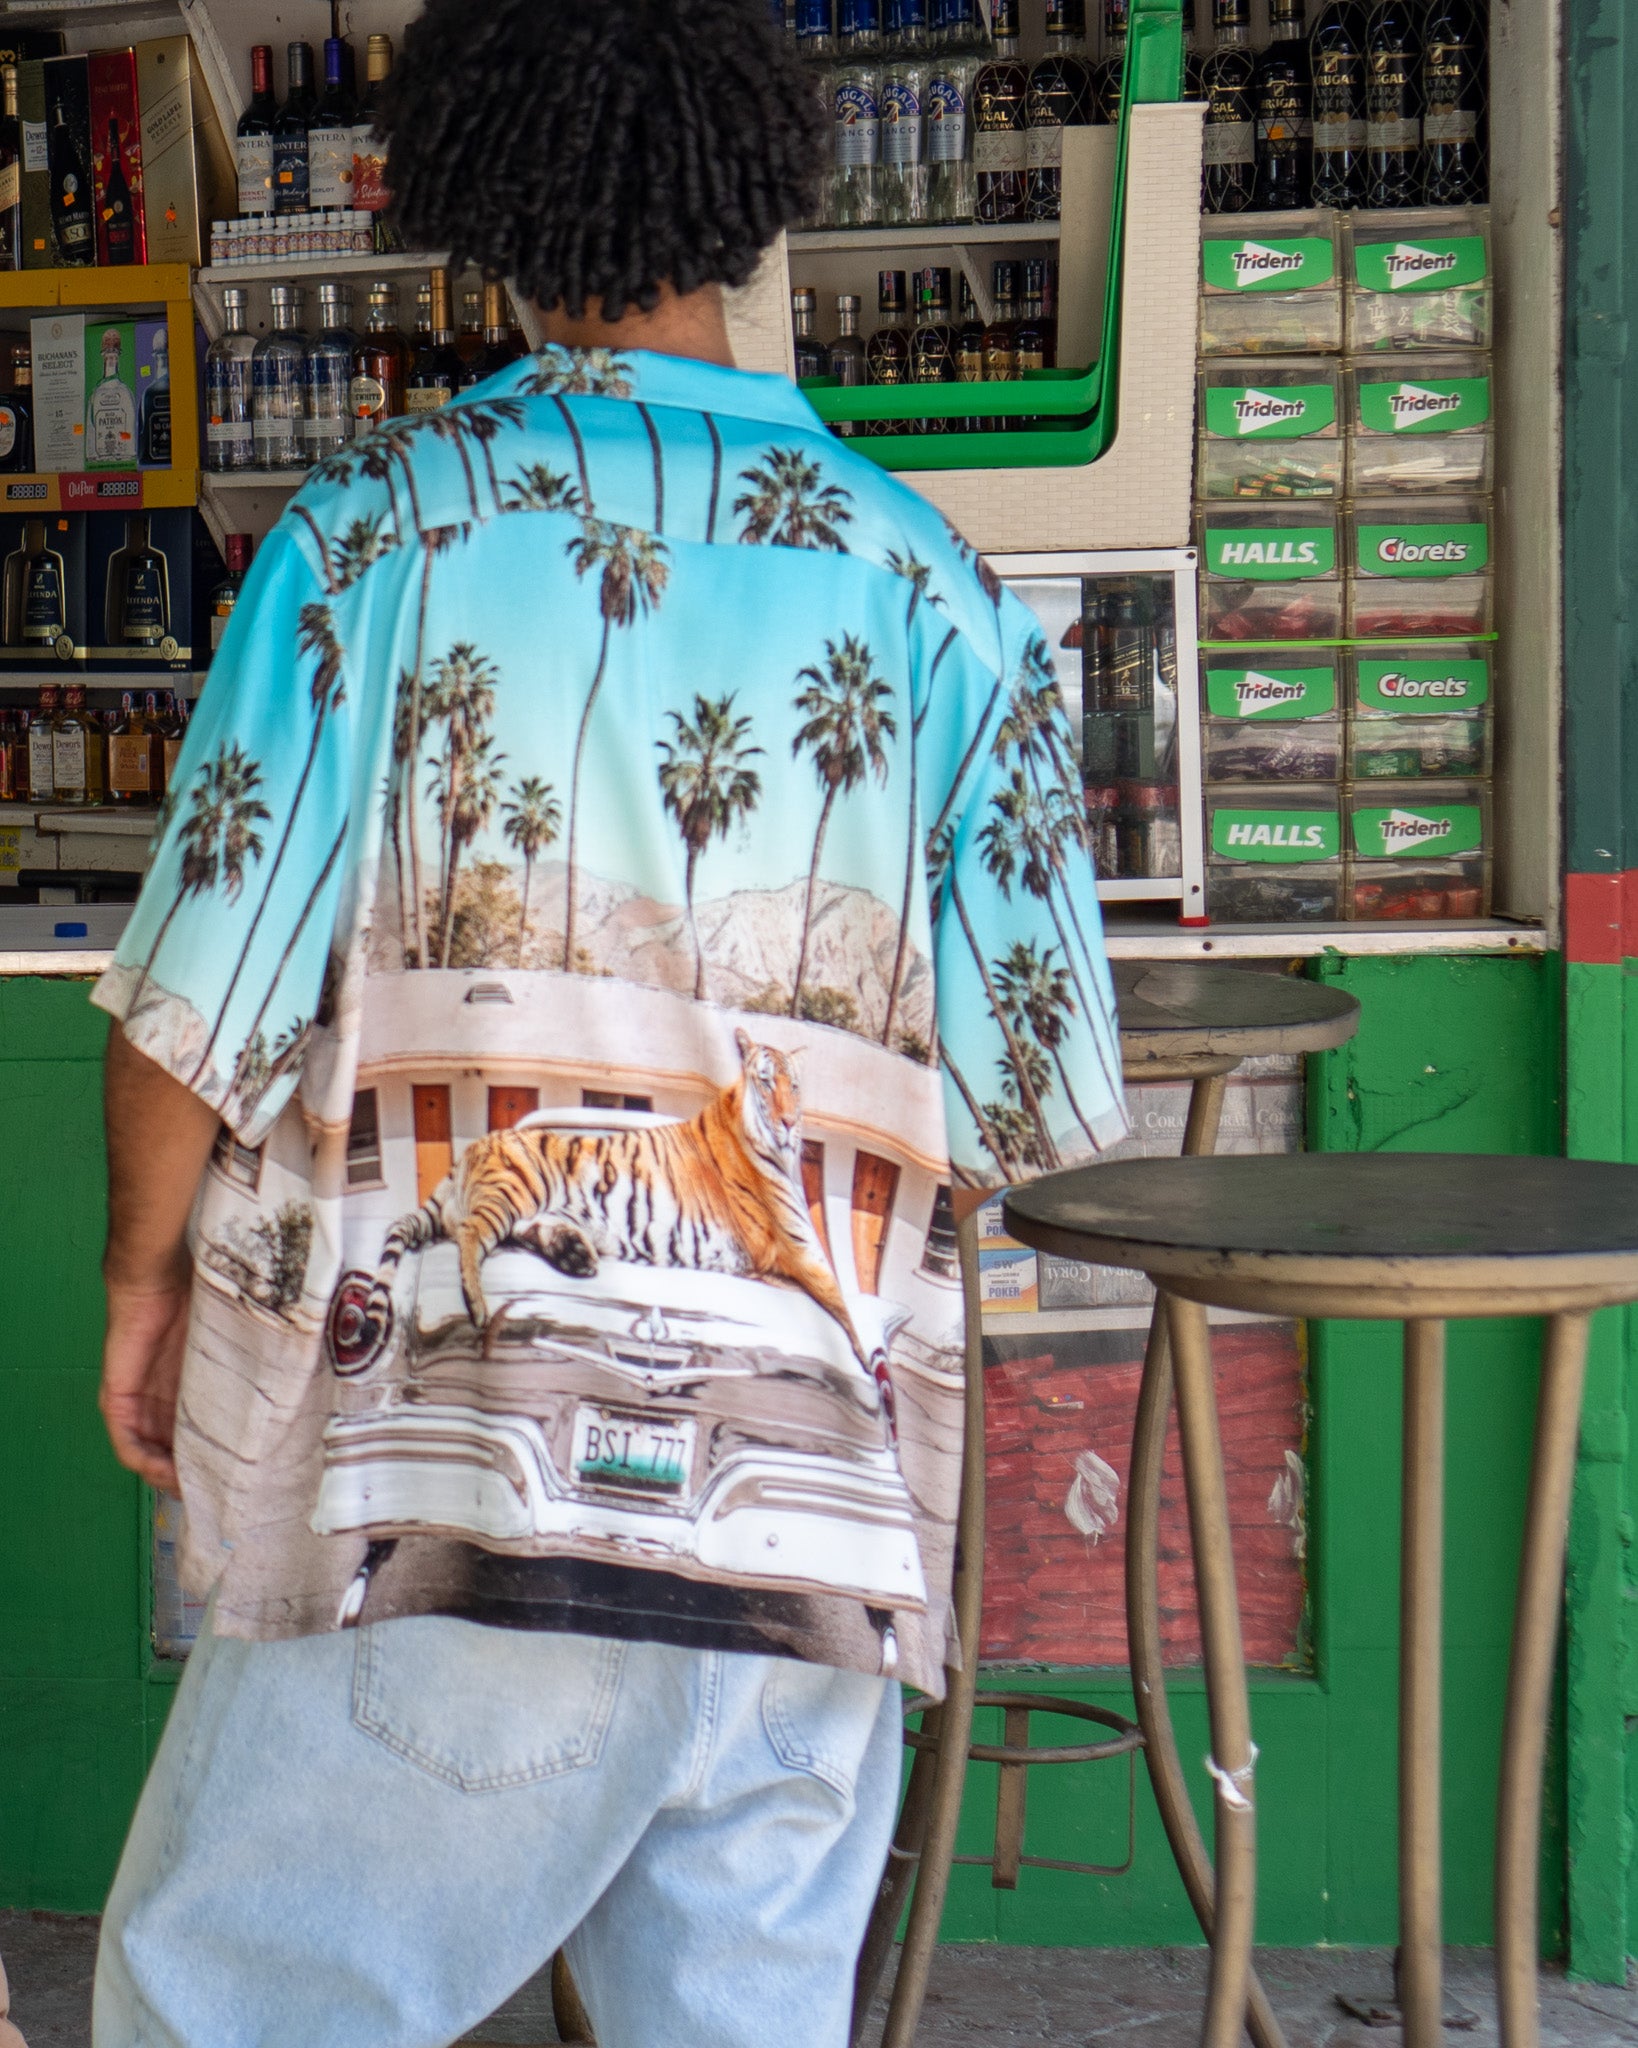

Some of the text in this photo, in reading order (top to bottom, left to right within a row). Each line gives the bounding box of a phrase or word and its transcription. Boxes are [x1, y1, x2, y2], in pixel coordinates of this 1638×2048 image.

[1426, 65, 1462, 77] UGAL
[882, 86, 913, 109] UGAL
[928, 83, 958, 106] UGAL
[1211, 102, 1235, 113] GAL
[26, 131, 47, 142] Dewa
[886, 126, 917, 135] ANCO
[930, 124, 961, 132] ANCO
[274, 141, 308, 150] ONTER
[1233, 252, 1303, 270] Trident
[1386, 253, 1456, 272] Trident
[37, 351, 78, 361] BUCHANAN'S
[42, 360, 74, 370] SELECT
[206, 361, 245, 374] SOLUT
[1236, 399, 1304, 417] Trident
[1391, 393, 1460, 412] Trident
[1220, 542, 1316, 565] HALLS
[1378, 537, 1468, 562] Clorets
[1236, 681, 1305, 699] Trident
[1378, 672, 1468, 698] Clorets
[33, 741, 51, 750] Dewa
[1227, 824, 1325, 848] HALLS
[1381, 819, 1451, 839] Trident
[1256, 1109, 1296, 1126] CORA
[986, 1225, 1007, 1236] POK
[988, 1286, 1021, 1298] POKER
[650, 1435, 687, 1475] 777
